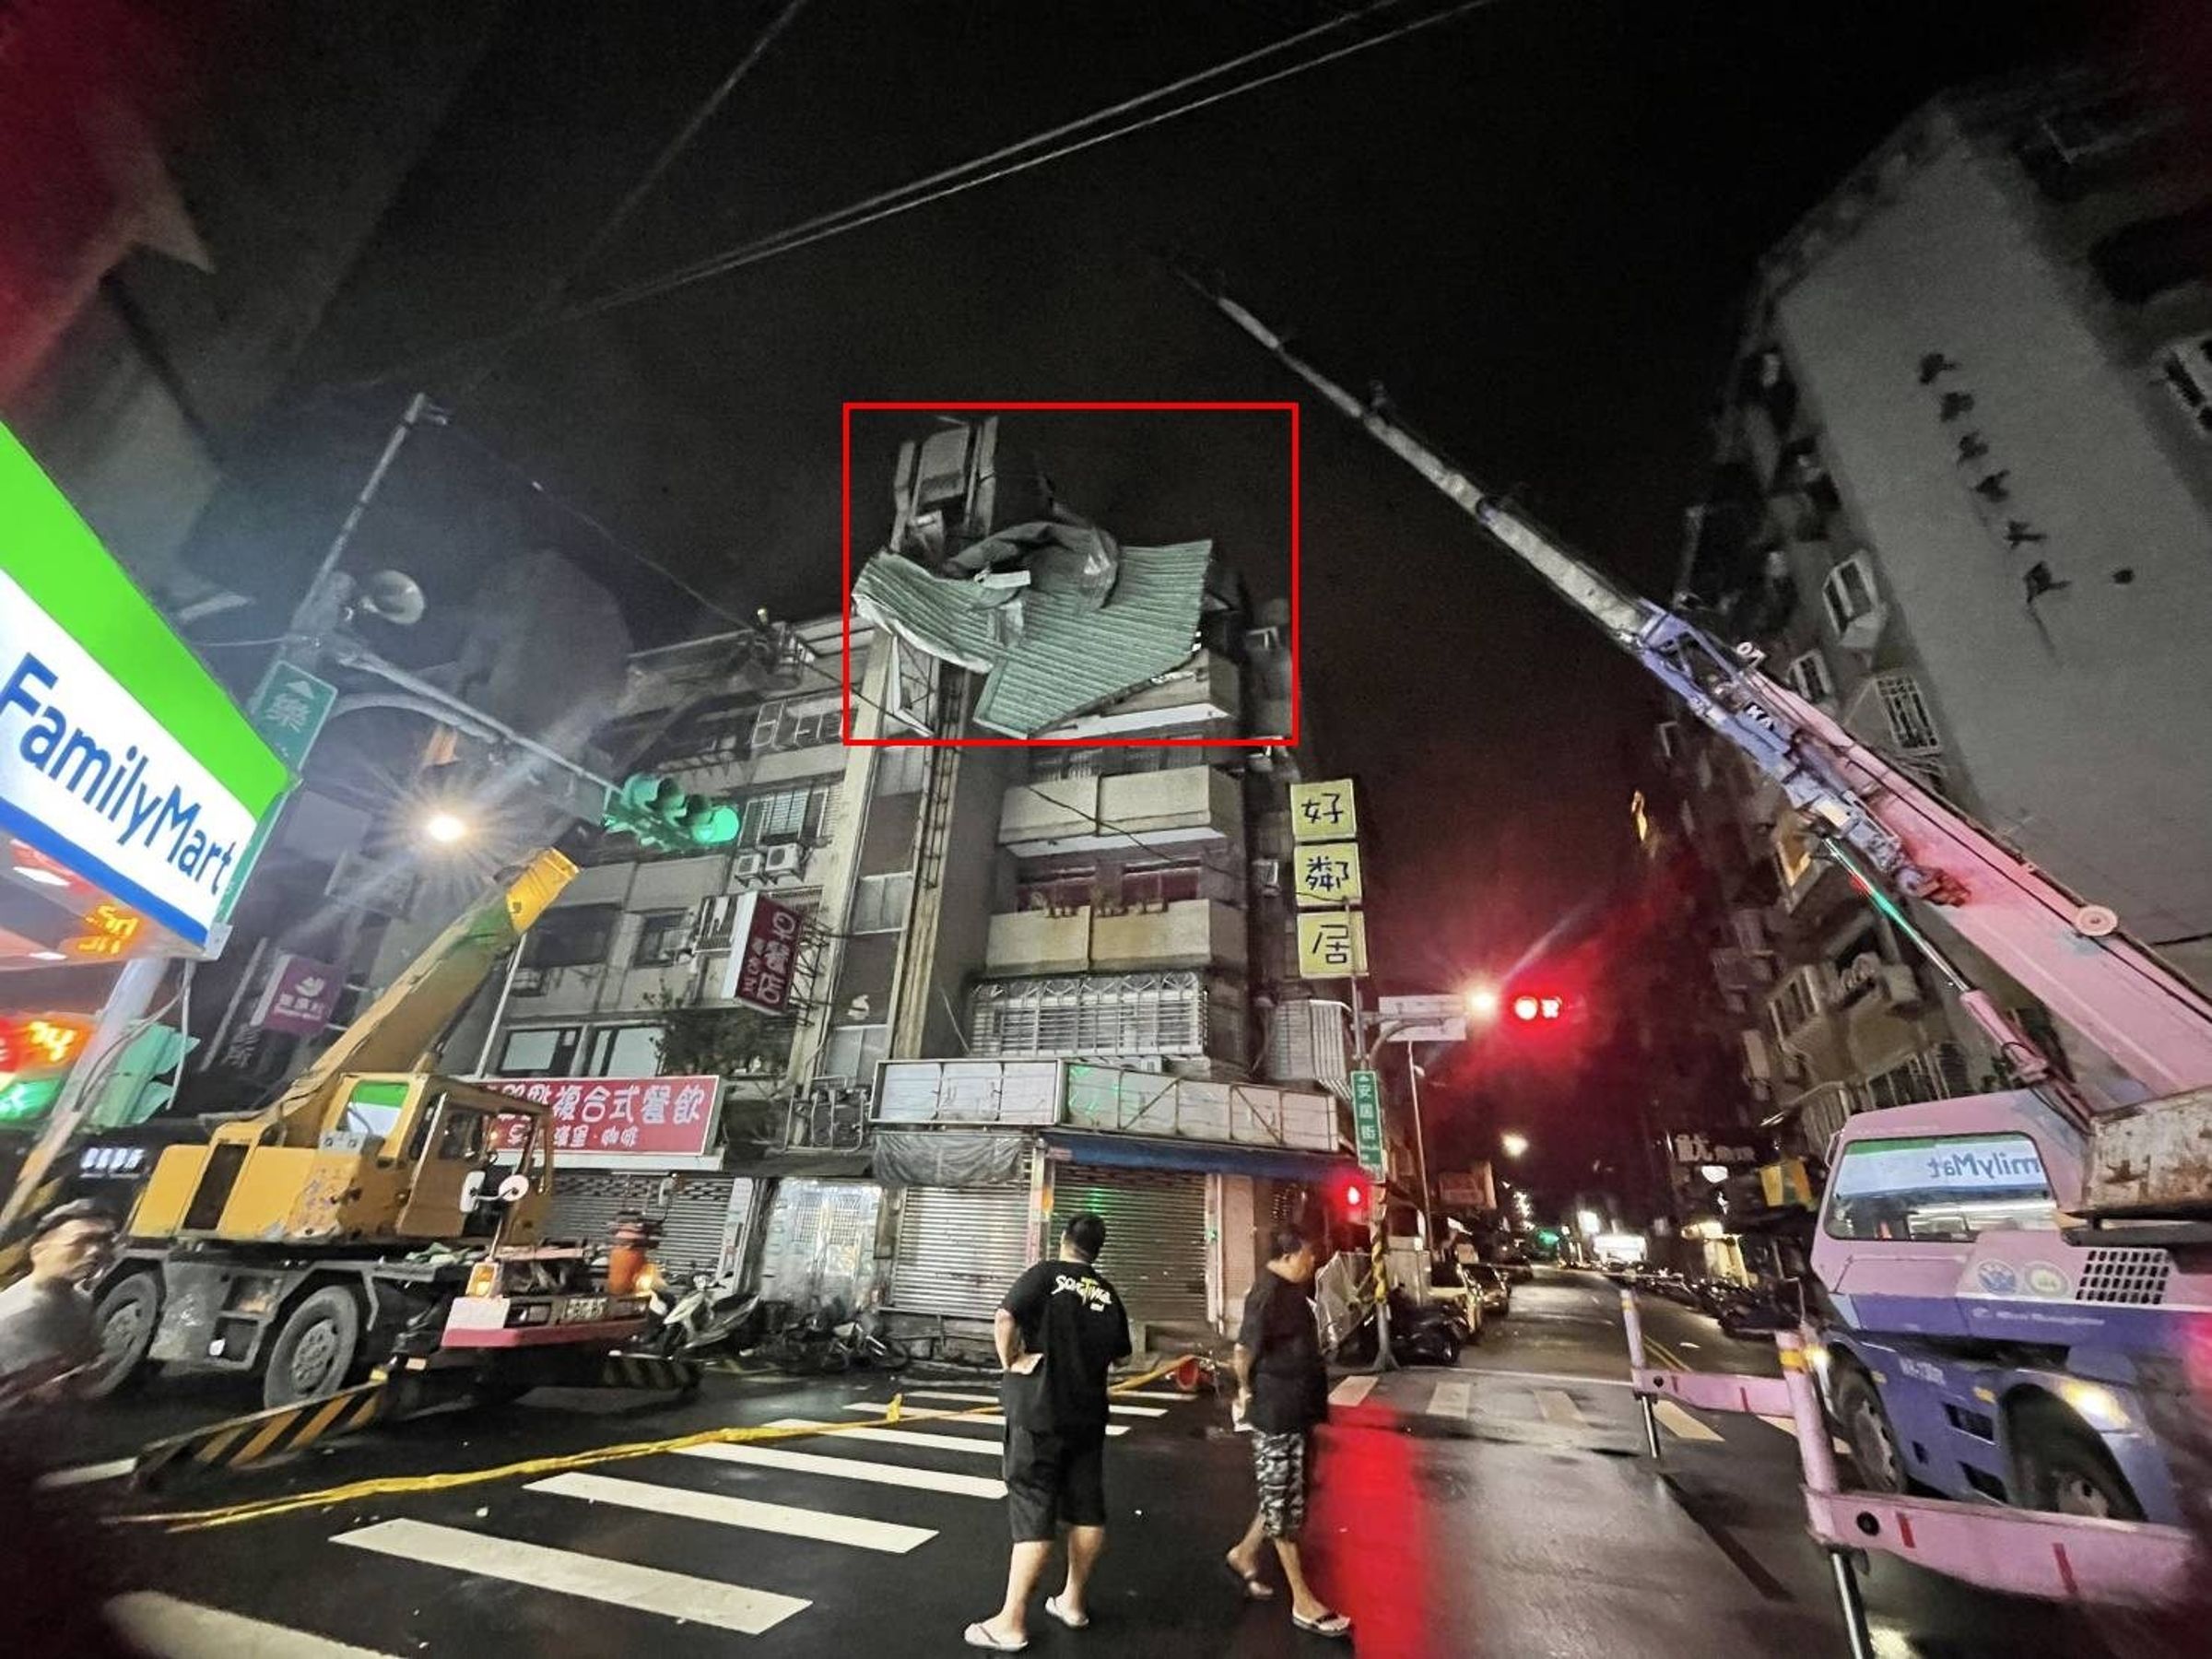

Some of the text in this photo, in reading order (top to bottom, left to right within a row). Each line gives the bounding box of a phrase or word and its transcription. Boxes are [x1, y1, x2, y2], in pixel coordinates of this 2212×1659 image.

[0, 652, 237, 896] FamilyMart
[1300, 793, 1349, 964] 好鄰居
